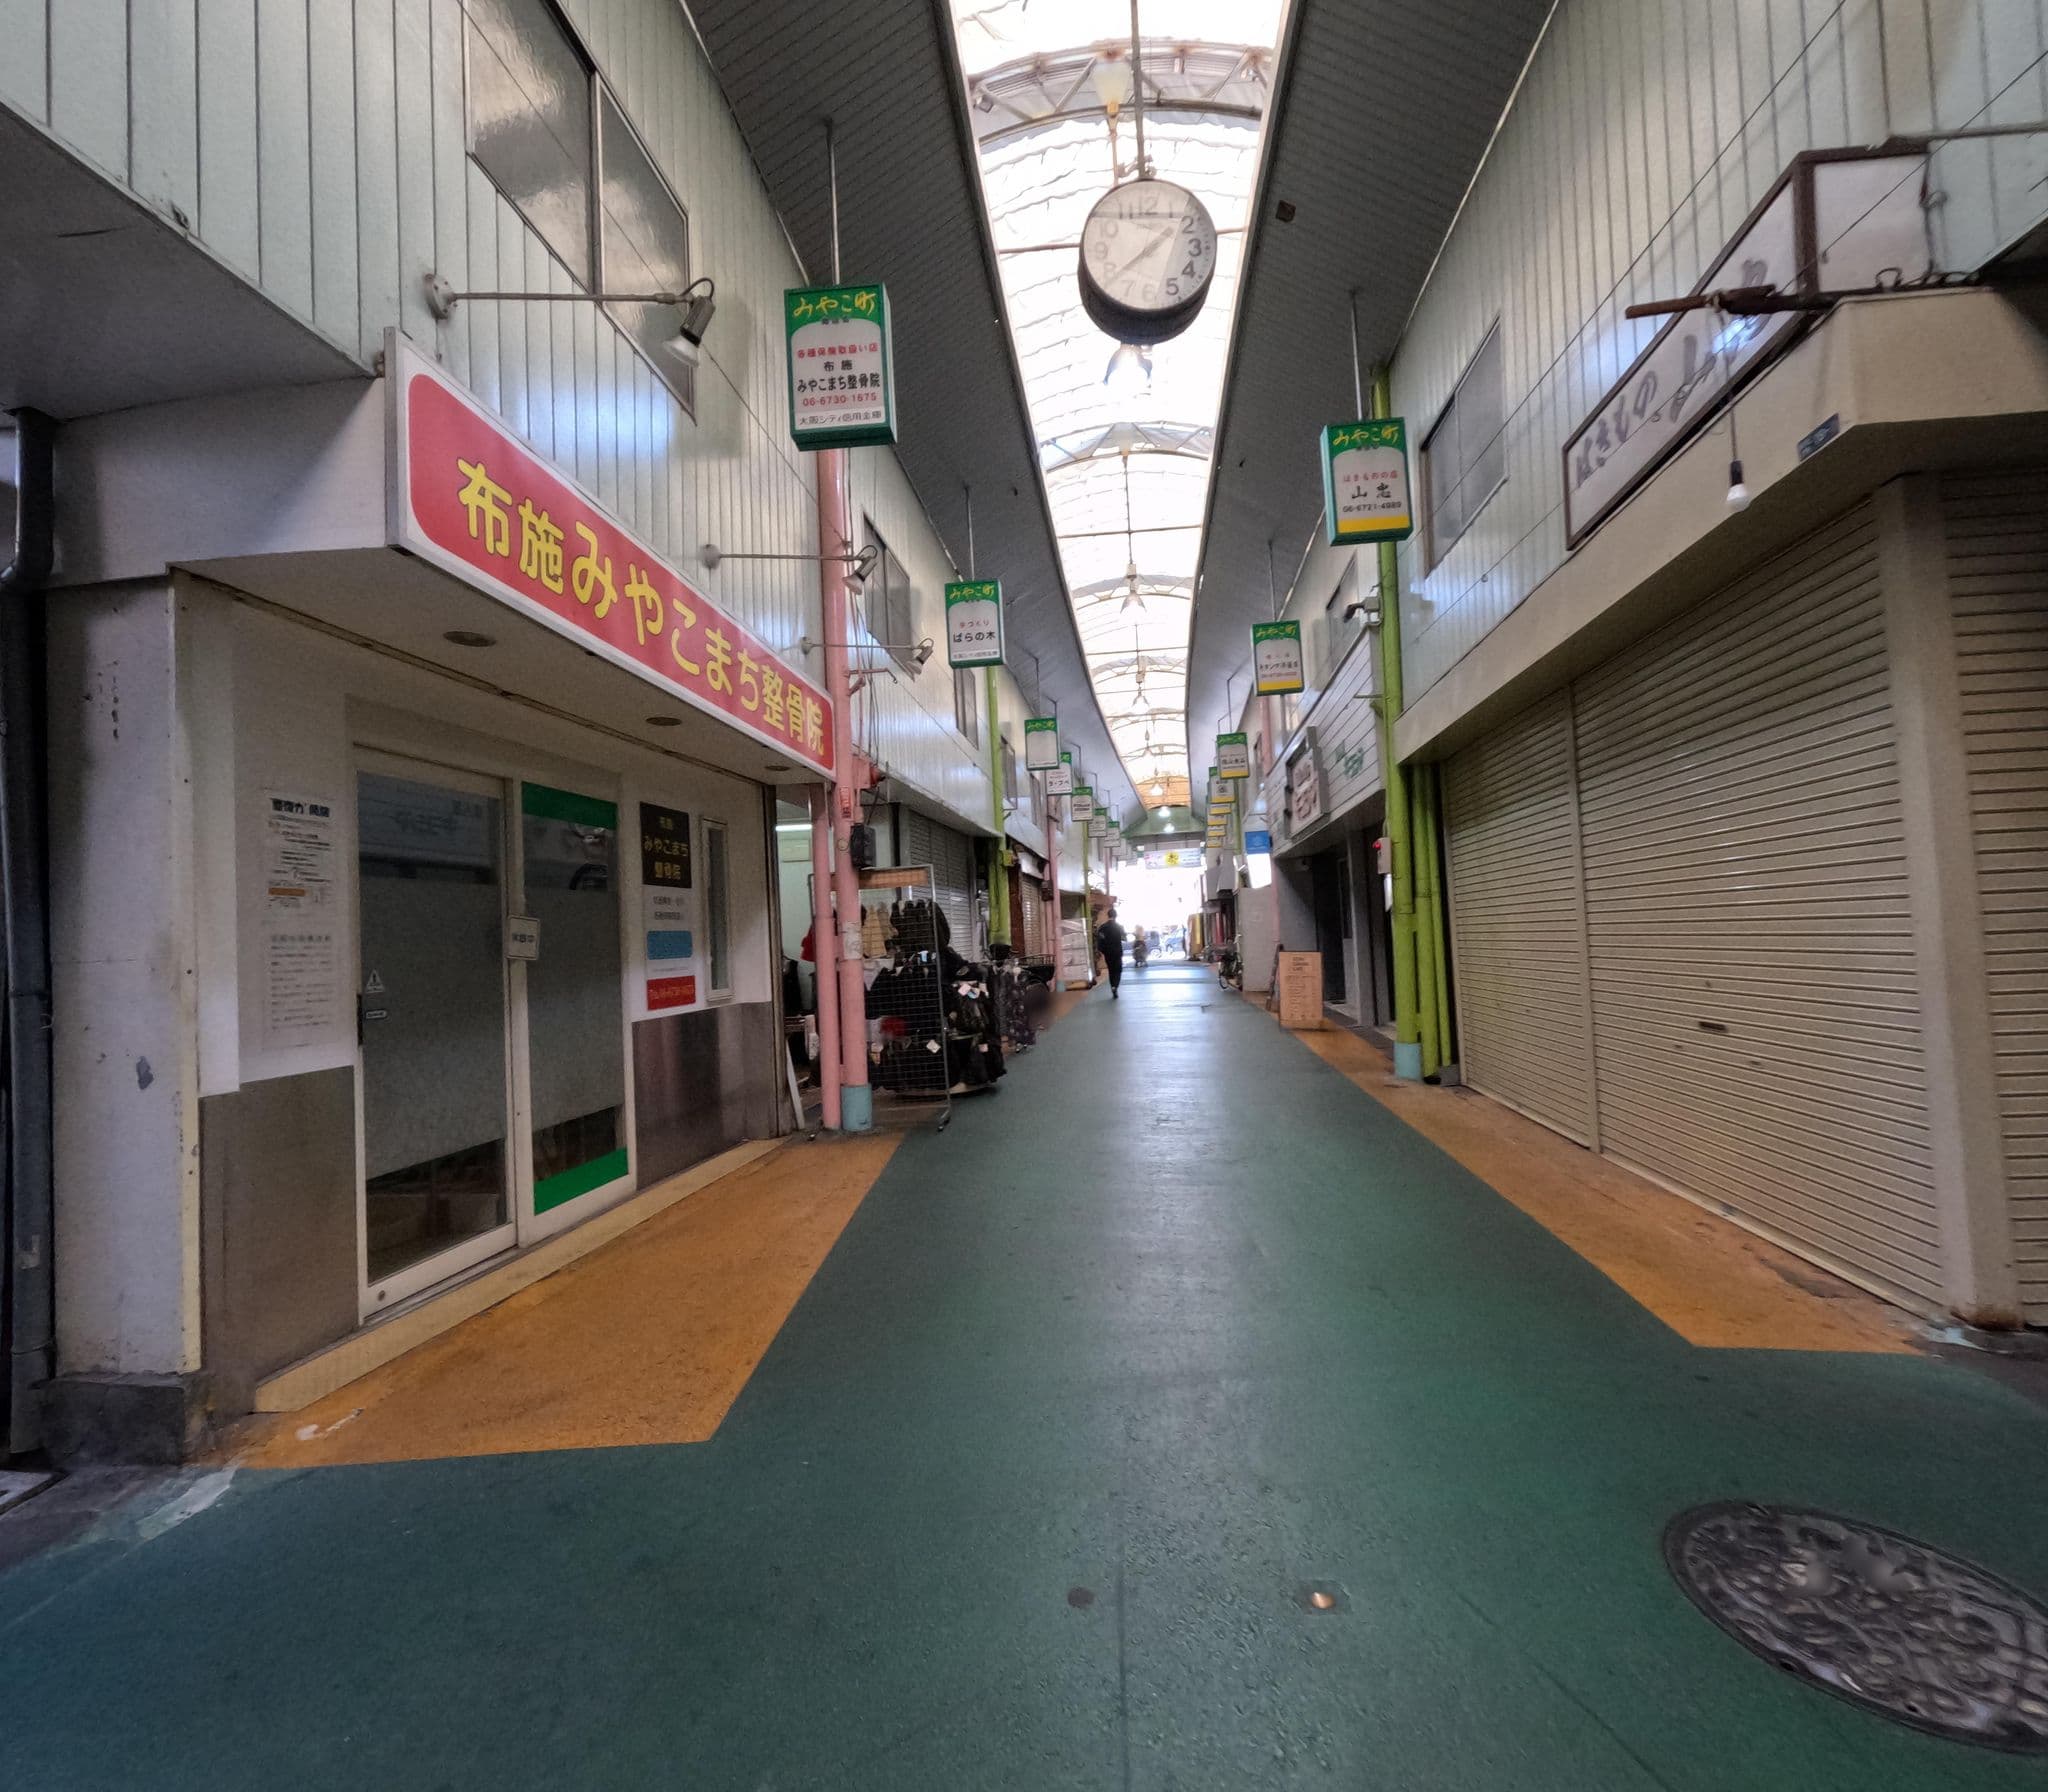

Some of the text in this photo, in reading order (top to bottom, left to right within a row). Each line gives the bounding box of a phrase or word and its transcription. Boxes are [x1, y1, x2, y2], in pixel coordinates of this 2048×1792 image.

[1099, 220, 1119, 239] 10
[1181, 215, 1194, 234] 2
[1093, 241, 1109, 261] 9
[1188, 238, 1202, 257] 3
[1181, 259, 1197, 279] 4
[1120, 280, 1137, 297] 7
[1166, 277, 1180, 296] 5
[794, 291, 877, 318] みやこ町
[823, 359, 853, 372] 布施
[796, 372, 881, 393] みやこまち整骨院
[1332, 424, 1400, 447] みやこ町
[949, 584, 995, 600] みやこ町
[457, 456, 825, 758] 布施みやこまち整骨院
